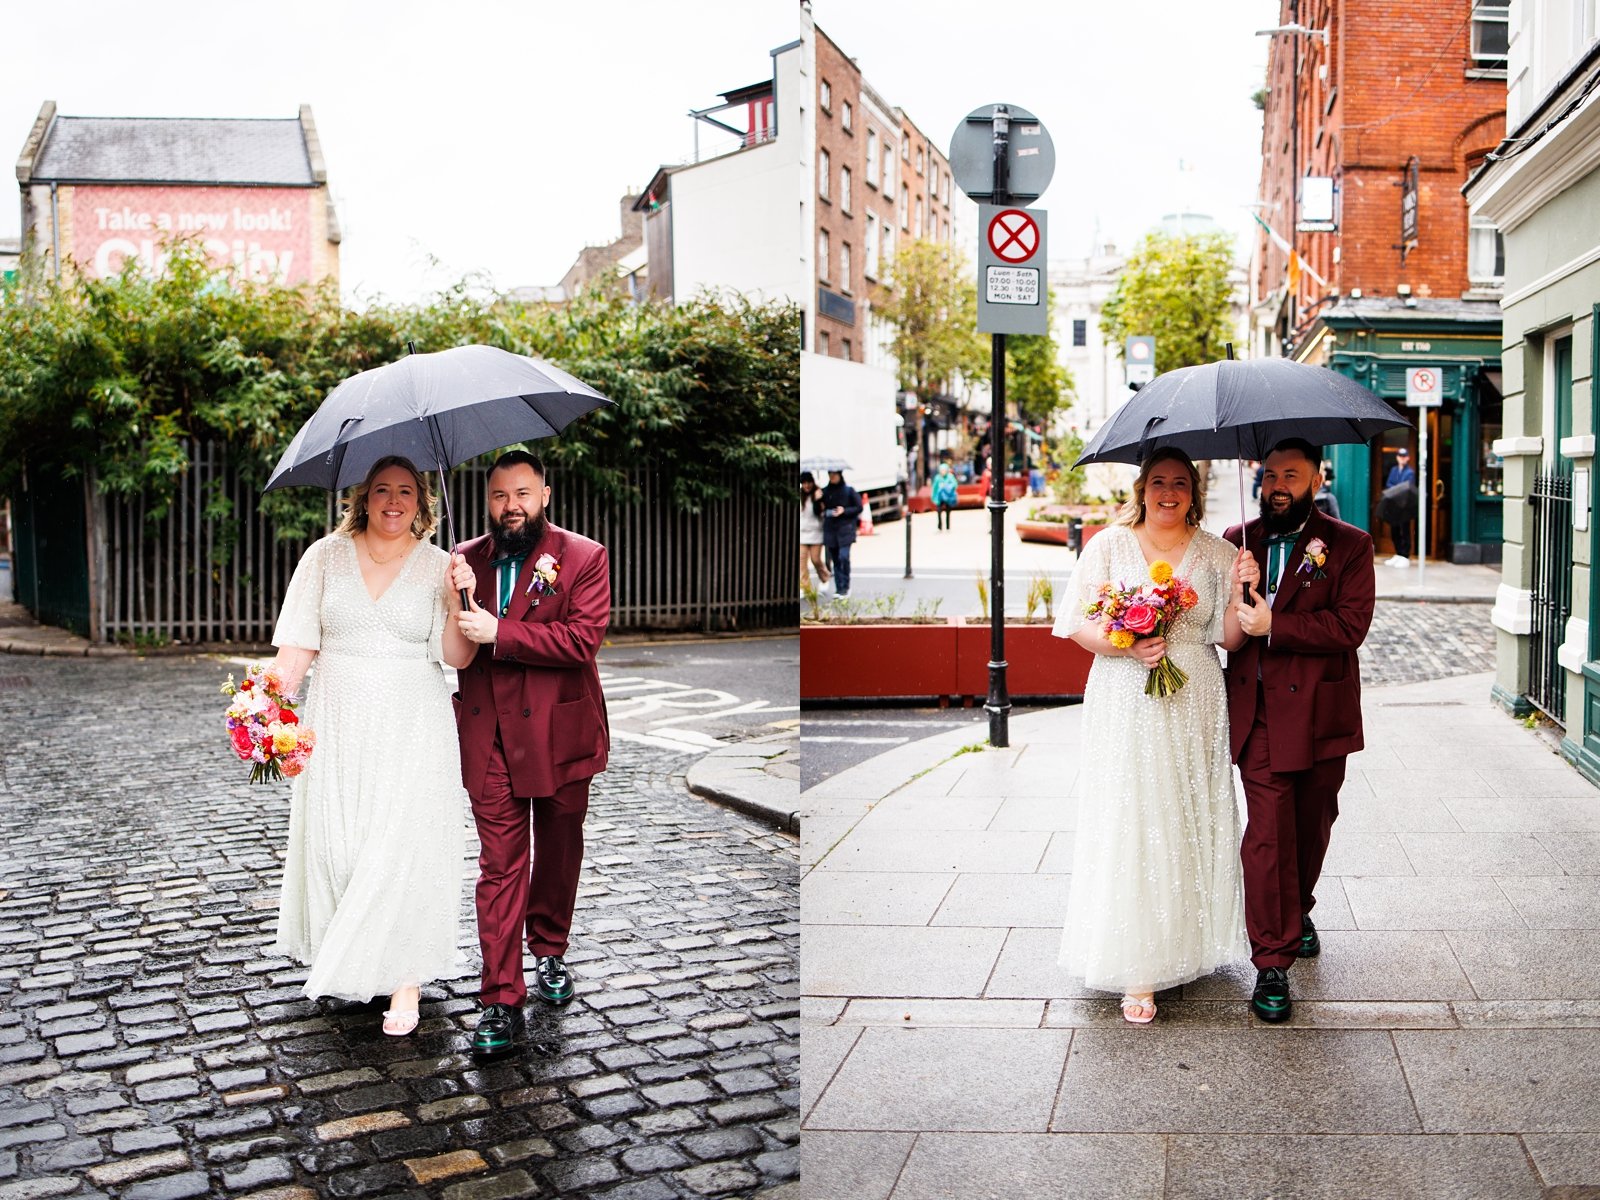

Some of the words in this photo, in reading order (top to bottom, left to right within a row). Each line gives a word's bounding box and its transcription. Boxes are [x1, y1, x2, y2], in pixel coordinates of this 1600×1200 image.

[94, 207, 150, 231] Take
[157, 212, 172, 231] a
[177, 212, 228, 231] new
[232, 206, 292, 232] look!
